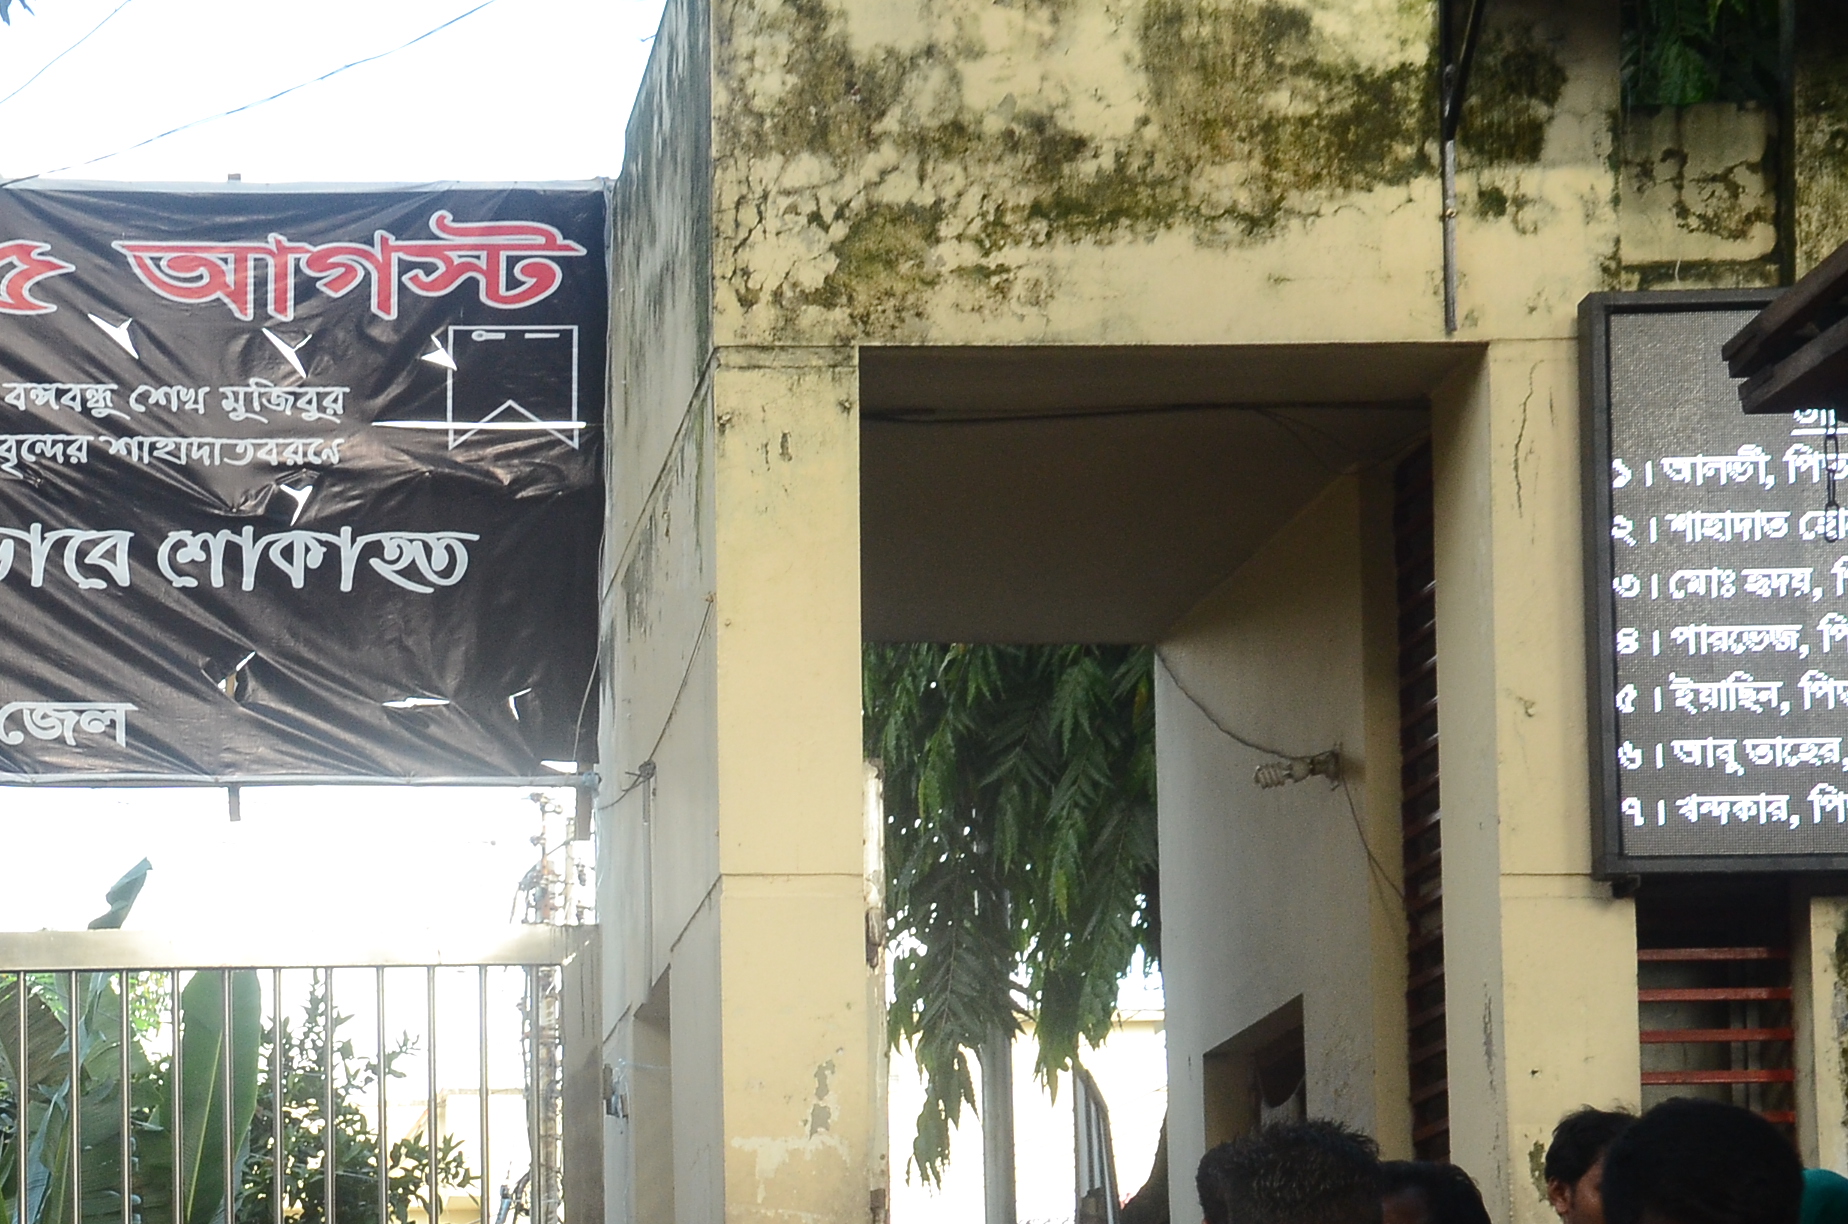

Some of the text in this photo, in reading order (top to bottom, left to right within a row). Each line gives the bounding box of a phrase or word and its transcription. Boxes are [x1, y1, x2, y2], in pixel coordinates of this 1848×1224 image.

[111, 210, 587, 322] আগস্ট
[3, 382, 130, 420] বঙ্গবন্ধু
[129, 385, 210, 414] শেখ
[219, 377, 349, 424] মুজিবুর
[158, 525, 480, 594] শোকাহত
